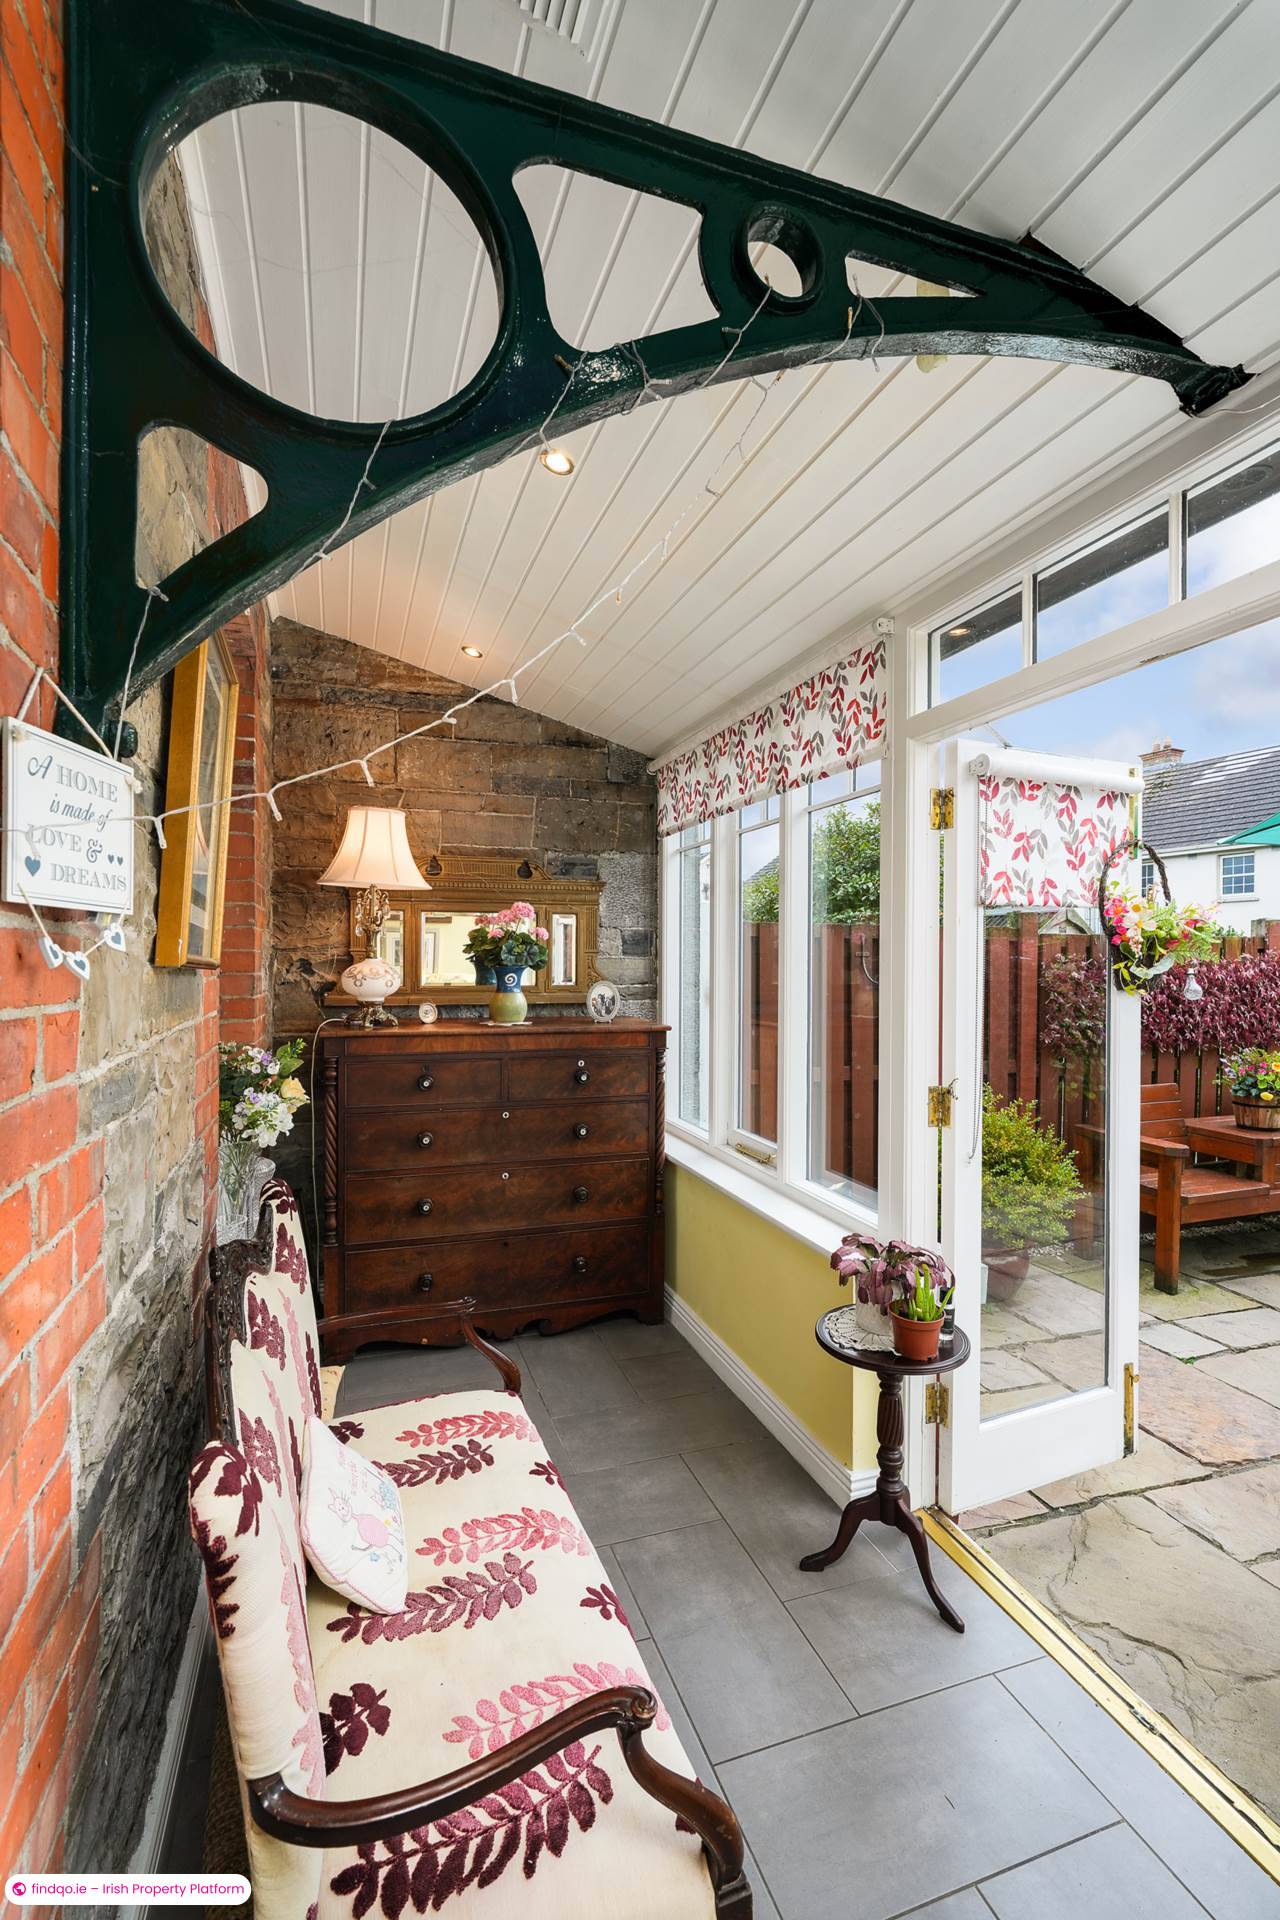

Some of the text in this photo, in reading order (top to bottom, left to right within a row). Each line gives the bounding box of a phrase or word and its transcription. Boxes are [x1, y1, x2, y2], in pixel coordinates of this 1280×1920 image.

[27, 755, 118, 803] A HOME
[49, 793, 113, 832] is made of
[27, 823, 103, 863] LOVE &
[50, 863, 127, 892] DREAMS
